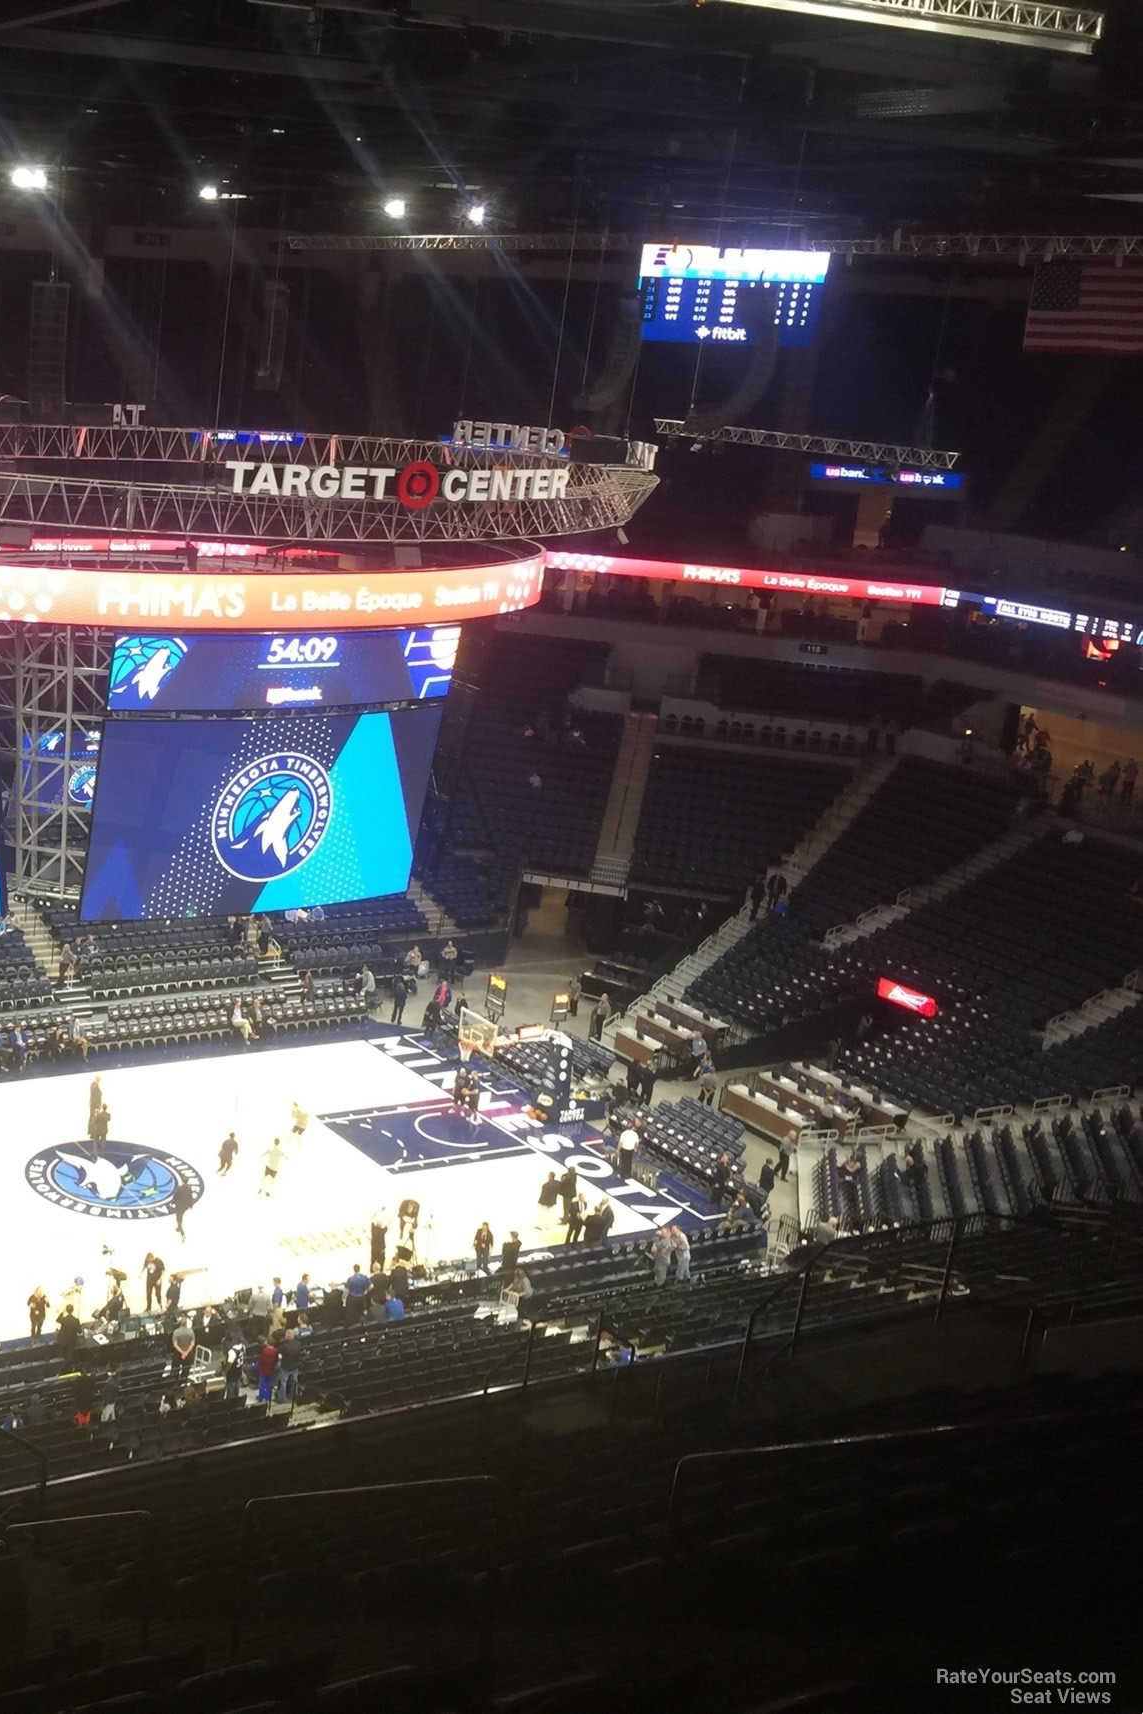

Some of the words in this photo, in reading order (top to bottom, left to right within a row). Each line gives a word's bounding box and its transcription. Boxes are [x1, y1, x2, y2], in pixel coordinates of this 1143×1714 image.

[712, 326, 747, 341] fitbit
[225, 460, 397, 500] TARGET
[441, 467, 570, 501] CENTER
[826, 466, 869, 479] usban
[270, 591, 296, 612] La
[300, 590, 350, 612] Belle
[355, 584, 423, 615] Époque
[434, 586, 482, 608] Section
[483, 582, 499, 602] 111
[266, 636, 338, 664] 54:09
[217, 758, 280, 839] MINNESOTA
[286, 757, 330, 857] TIMBERWOLVES
